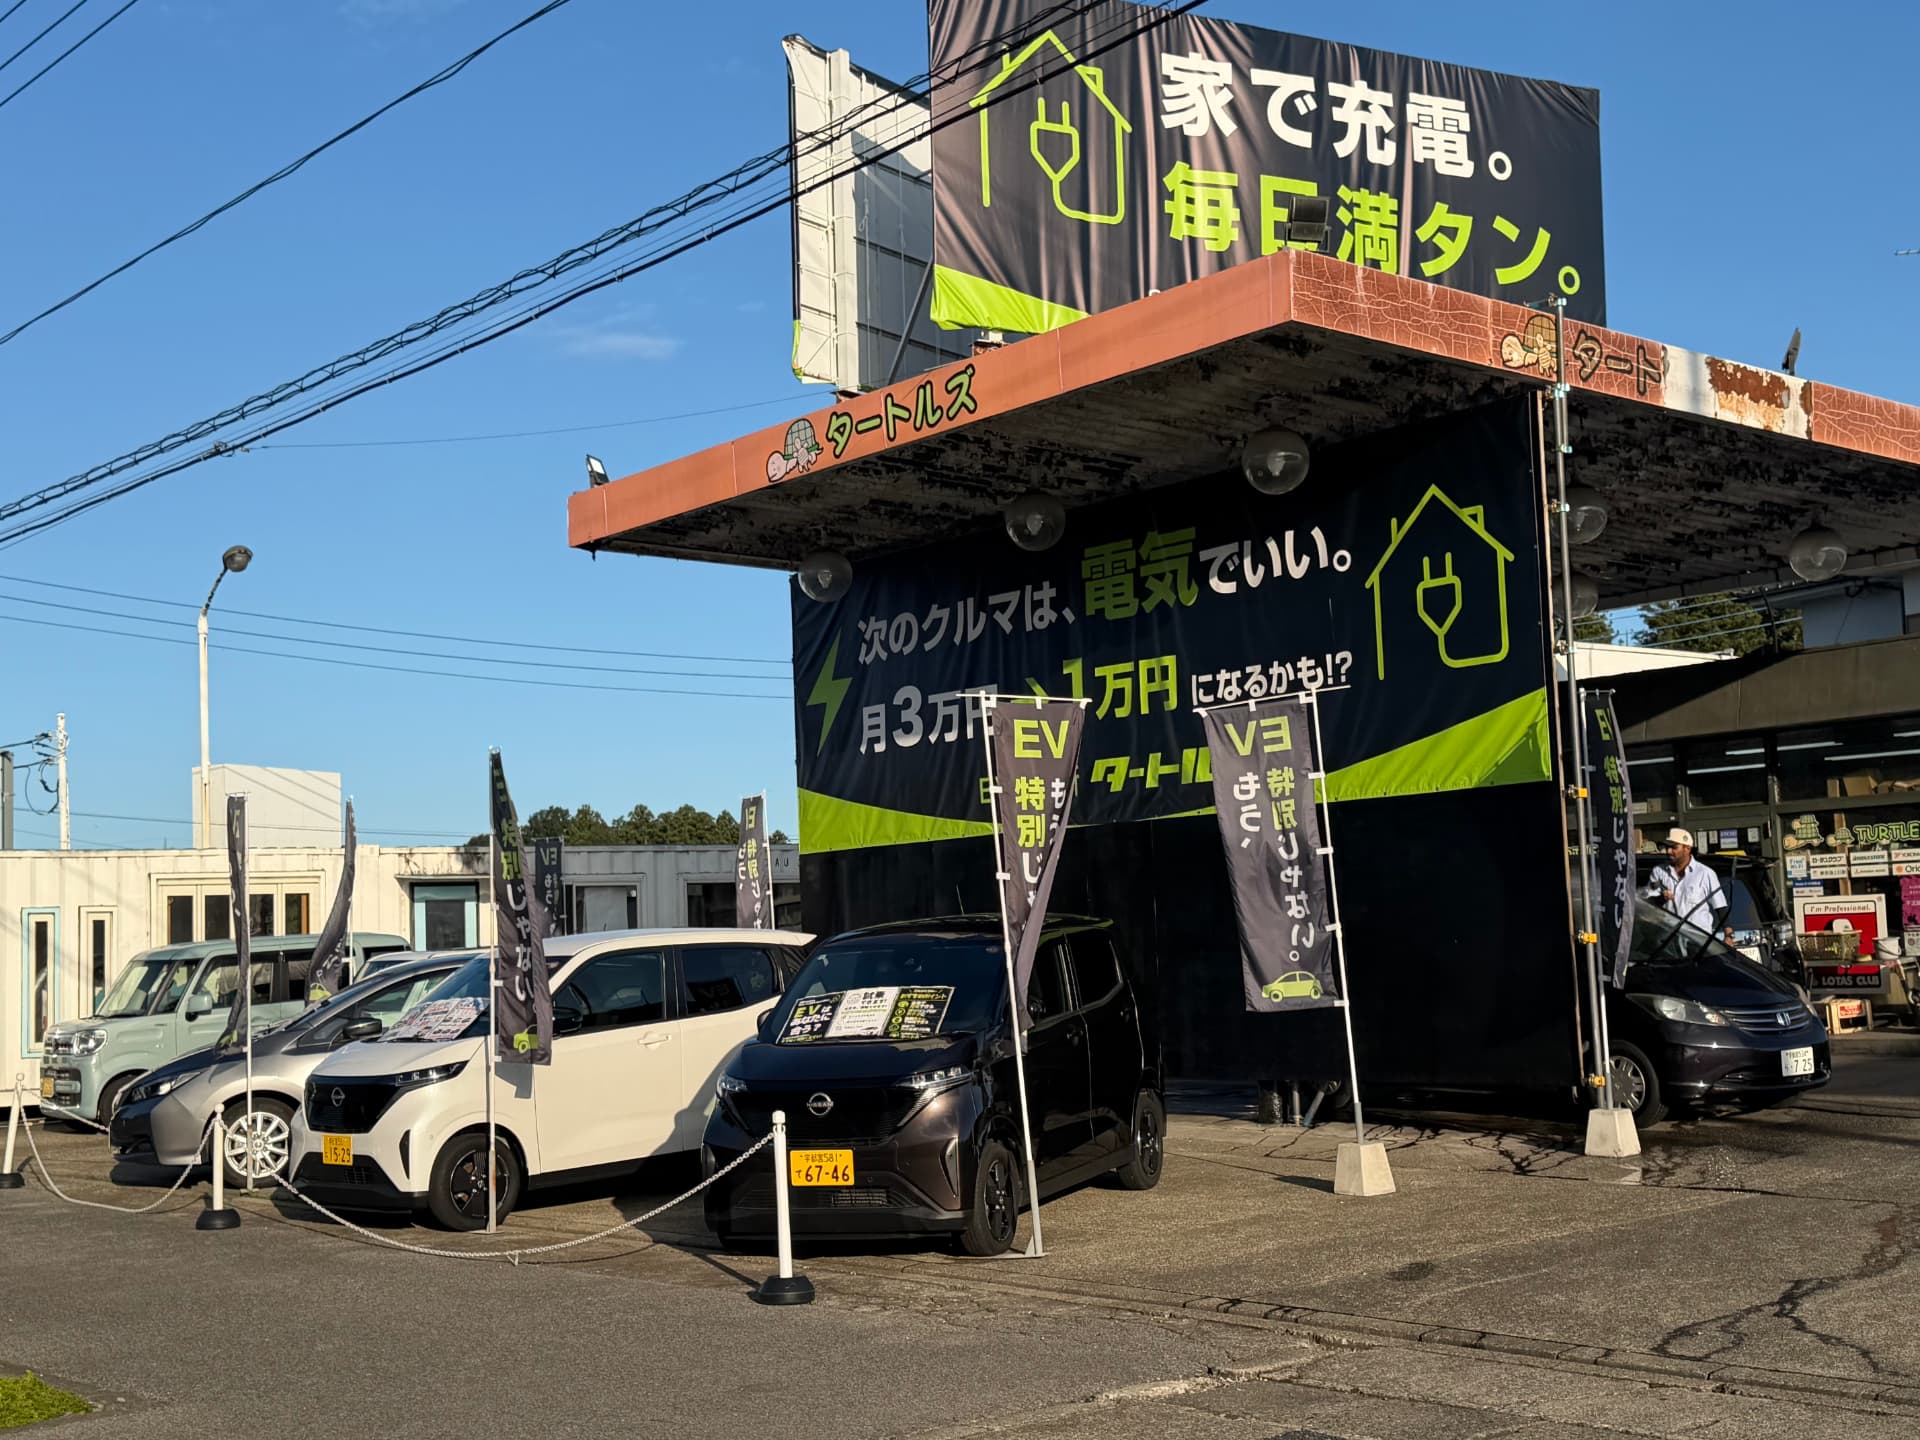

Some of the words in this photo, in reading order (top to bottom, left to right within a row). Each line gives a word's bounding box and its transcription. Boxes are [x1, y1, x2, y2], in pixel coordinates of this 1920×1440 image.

[1160, 52, 1513, 181] 家で充電。
[826, 363, 978, 459] タートルズ
[859, 684, 999, 755] 月3万円
[1013, 719, 1070, 759] EV
[1822, 976, 1853, 986] LOTAS
[1859, 975, 1880, 985] CLUB
[805, 1164, 850, 1183] 67-46
